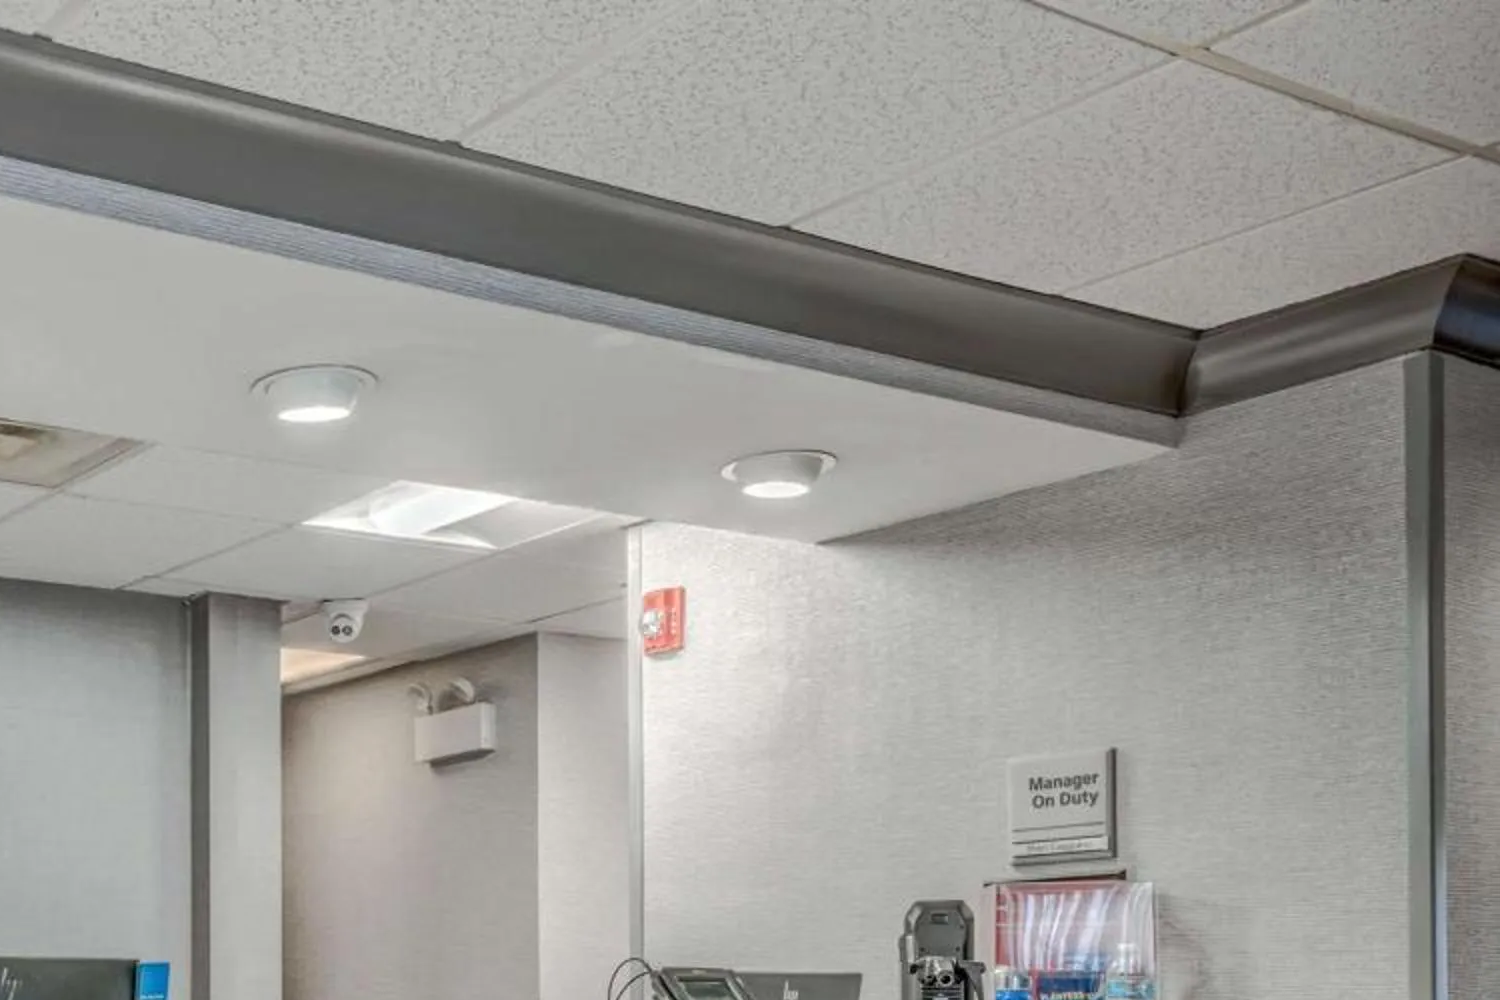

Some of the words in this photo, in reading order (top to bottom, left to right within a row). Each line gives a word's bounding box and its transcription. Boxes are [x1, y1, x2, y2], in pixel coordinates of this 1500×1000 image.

[1028, 773, 1099, 791] Manager
[1031, 795, 1055, 809] On
[1060, 791, 1099, 808] Duty
